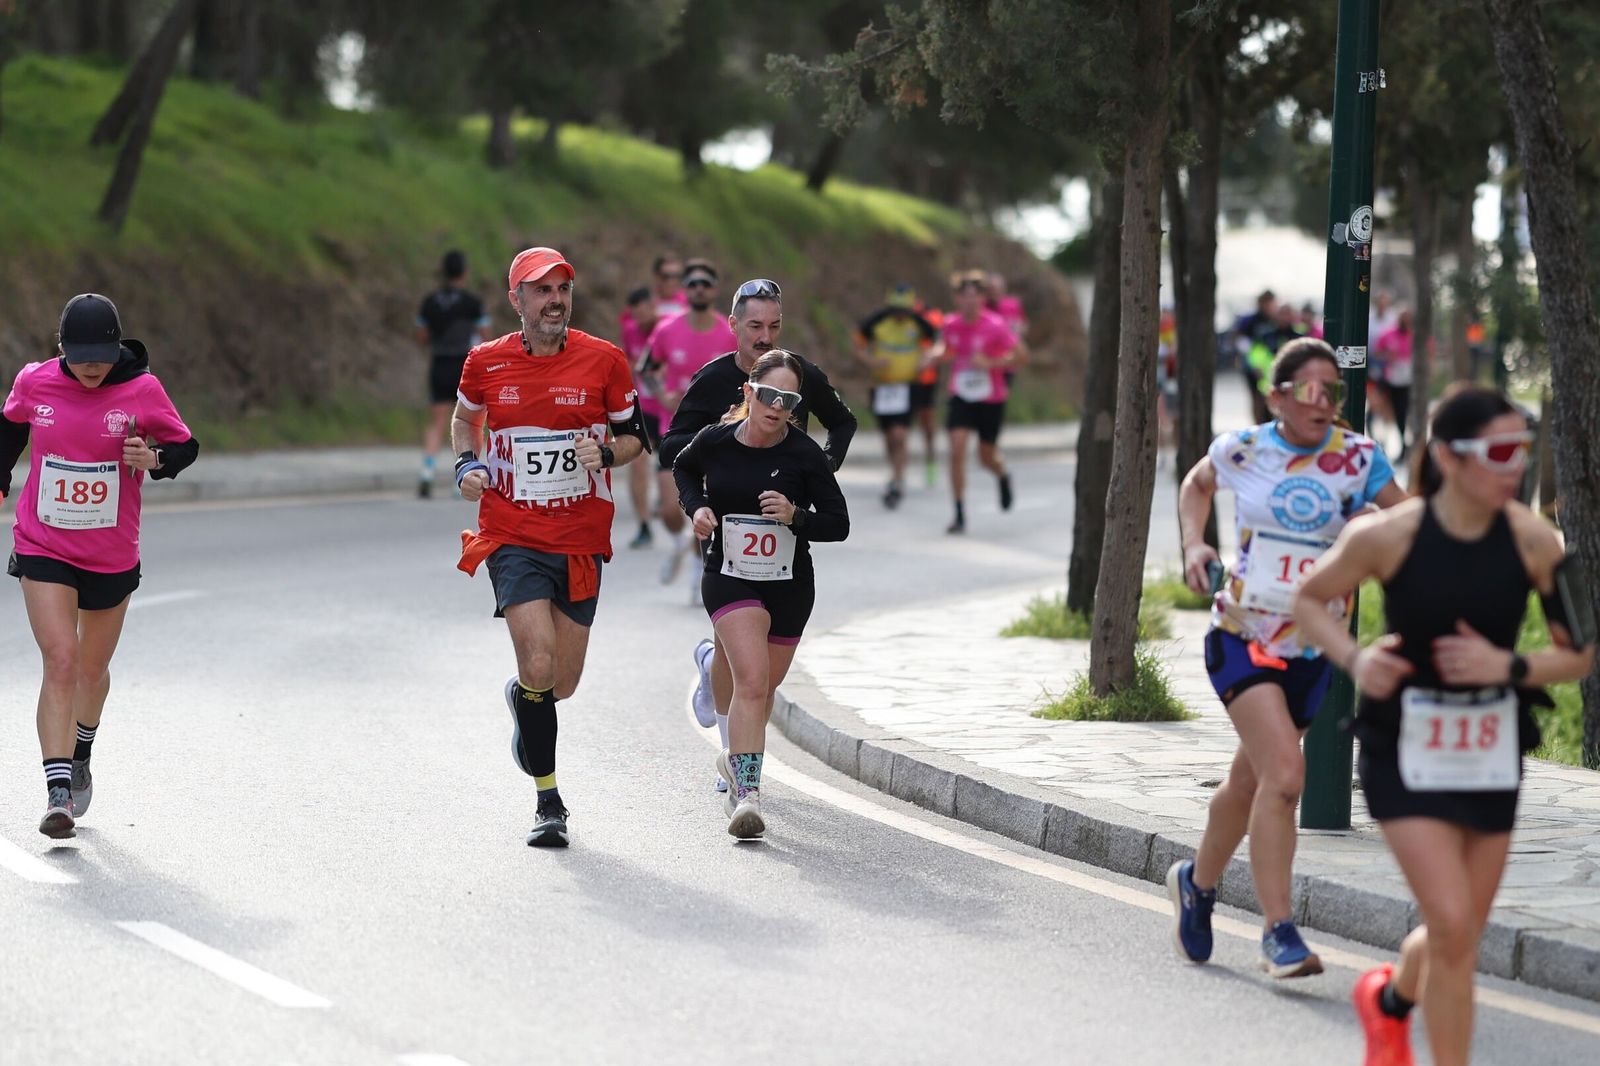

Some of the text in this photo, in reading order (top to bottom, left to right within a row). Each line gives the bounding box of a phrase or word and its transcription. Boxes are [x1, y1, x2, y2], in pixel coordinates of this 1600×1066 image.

[555, 396, 579, 405] MÁLAGA
[527, 448, 577, 475] 578
[54, 479, 108, 504] 189
[742, 533, 777, 557] 20
[1426, 714, 1500, 750] 118
